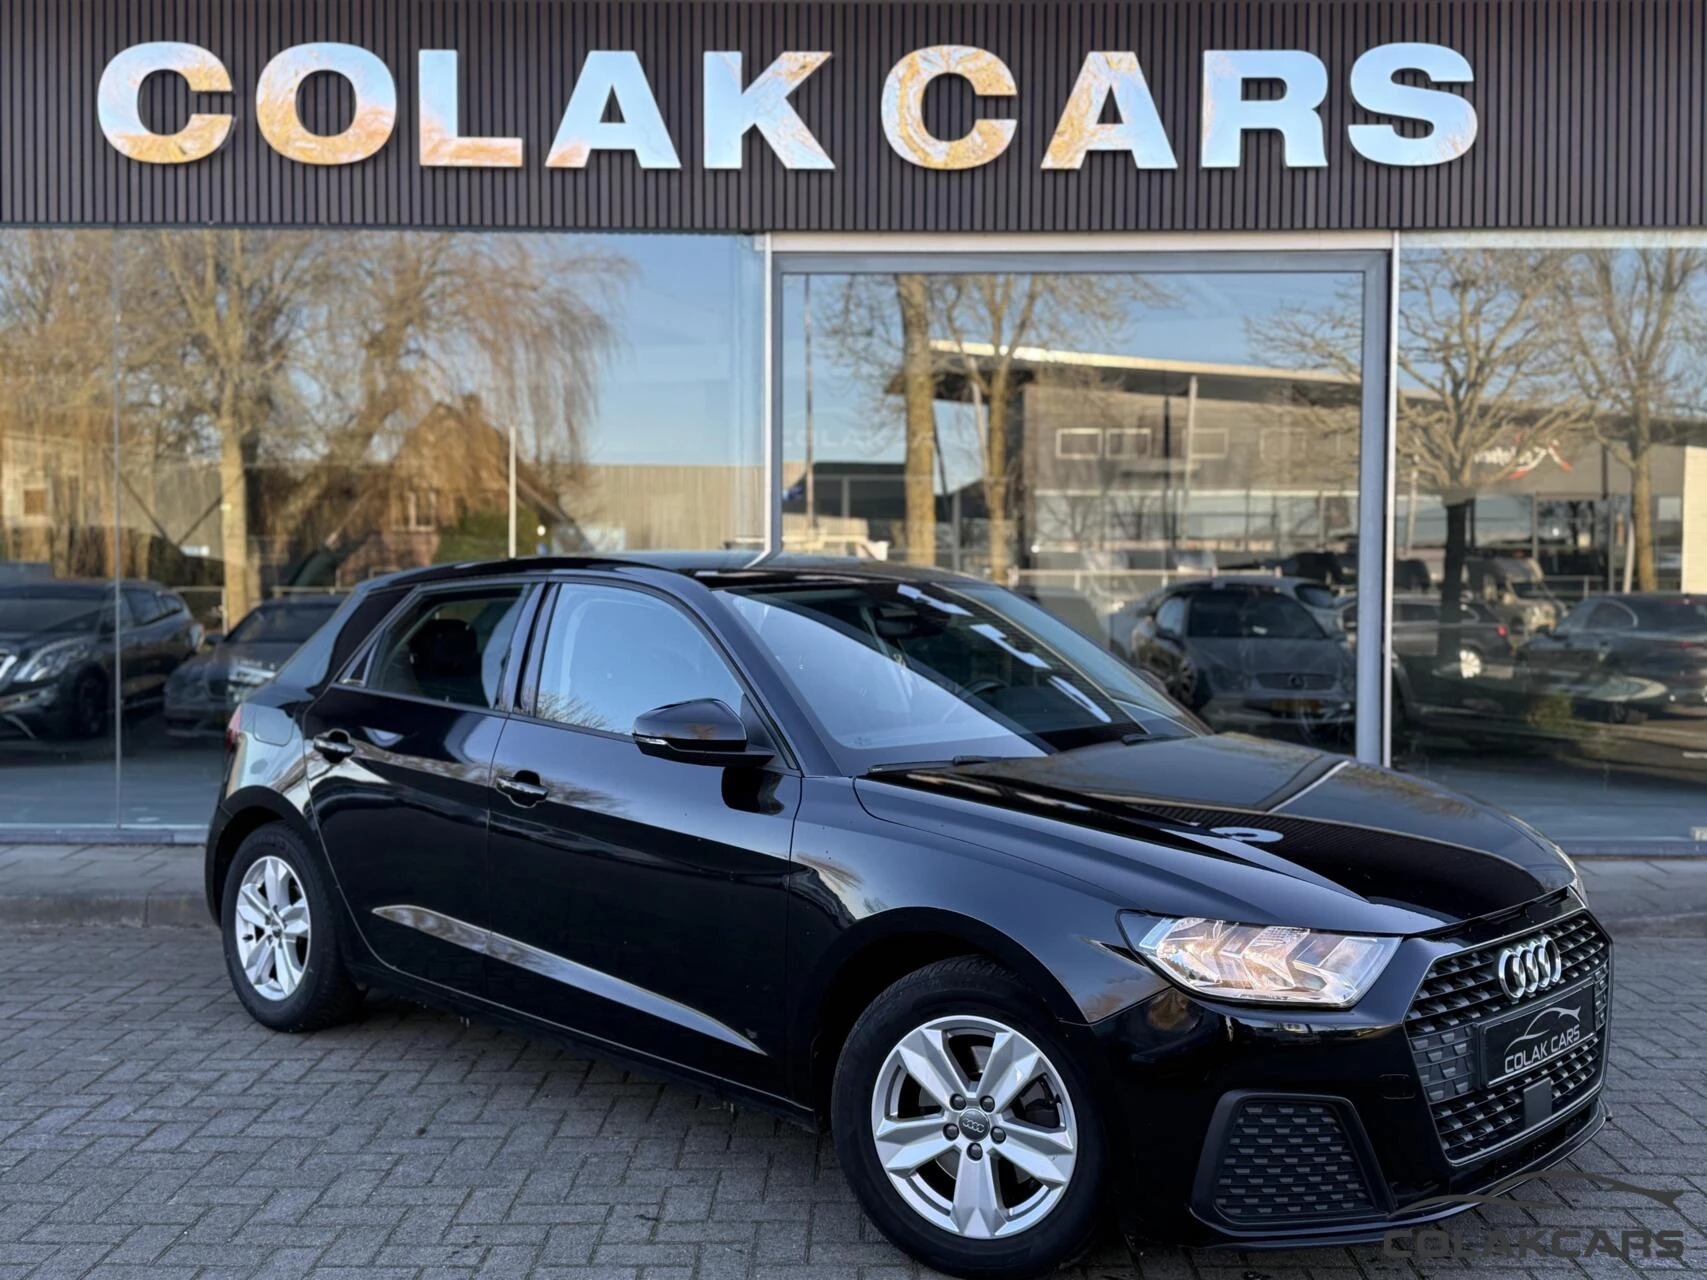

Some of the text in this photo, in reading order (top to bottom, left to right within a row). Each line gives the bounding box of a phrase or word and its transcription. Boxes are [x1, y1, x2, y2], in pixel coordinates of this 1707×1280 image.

[97, 41, 1478, 170] COLAK CARS
[1504, 1024, 1580, 1073] COLAK CARS
